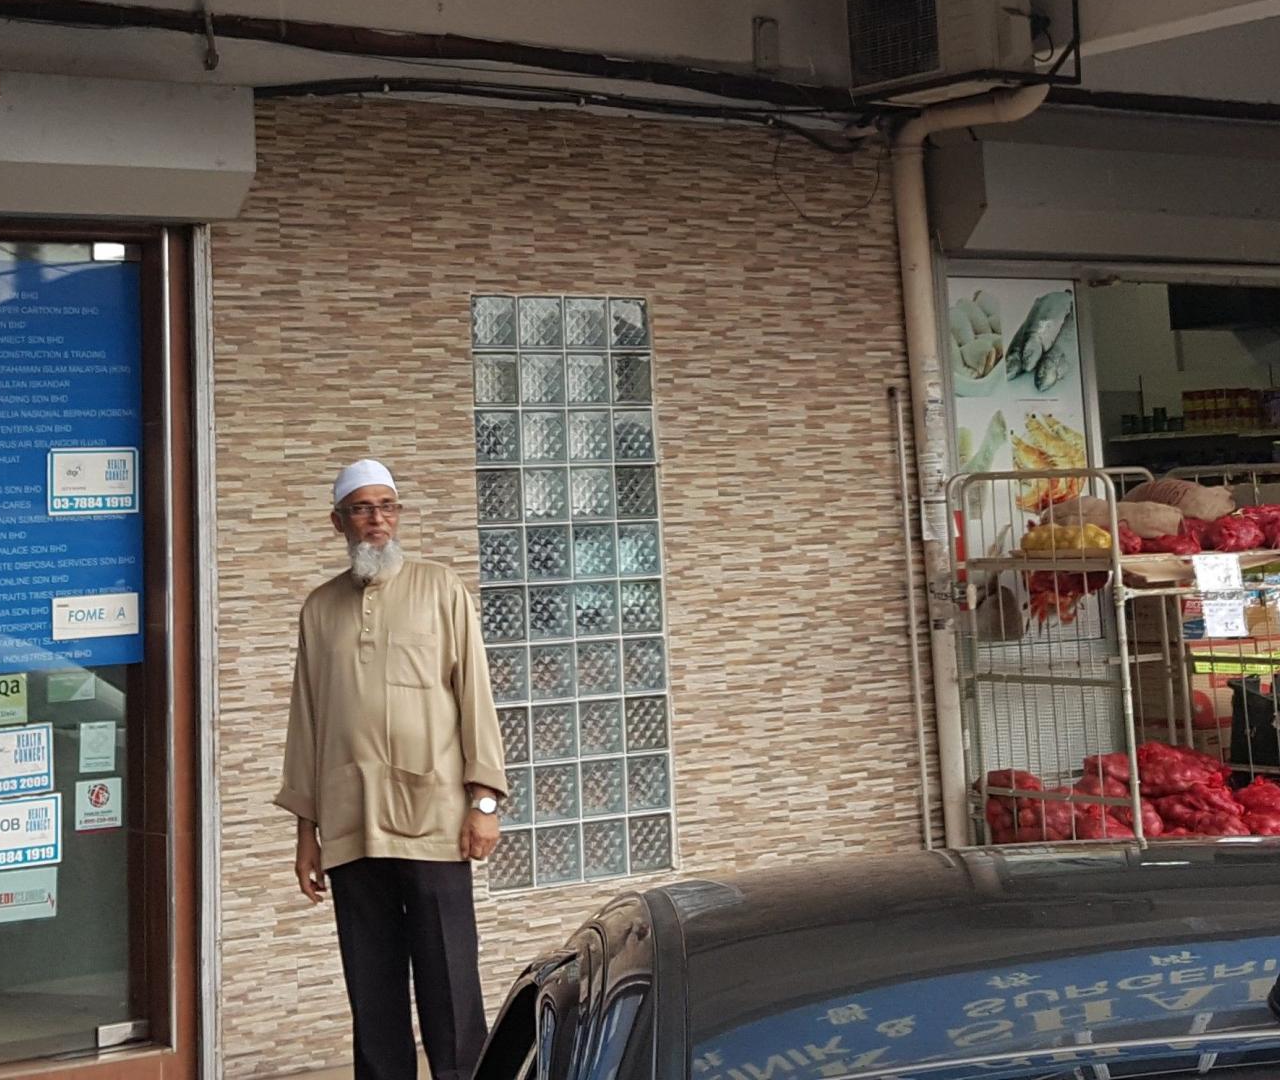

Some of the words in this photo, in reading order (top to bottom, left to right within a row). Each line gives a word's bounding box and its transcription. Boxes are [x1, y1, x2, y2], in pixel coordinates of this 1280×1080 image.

[70, 350, 106, 358] TRADING
[53, 496, 103, 510] 03-7884
[104, 495, 133, 508] 1919
[30, 546, 48, 554] SDN
[49, 545, 67, 553] BHD
[14, 561, 56, 570] DISPOSAL
[57, 559, 98, 568] SERVICES
[99, 557, 117, 565] SDN
[118, 556, 135, 564] BHD
[0, 578, 31, 586] ONLINE
[32, 576, 50, 584] SDN
[51, 575, 69, 583] BHD
[31, 606, 49, 615] BHD
[74, 650, 92, 658] BHD
[16, 732, 42, 748] HEALTH
[14, 746, 45, 763] CONNECT
[28, 807, 49, 820] HEALTH
[25, 819, 51, 833] CONNECT
[26, 846, 54, 861] 1919
